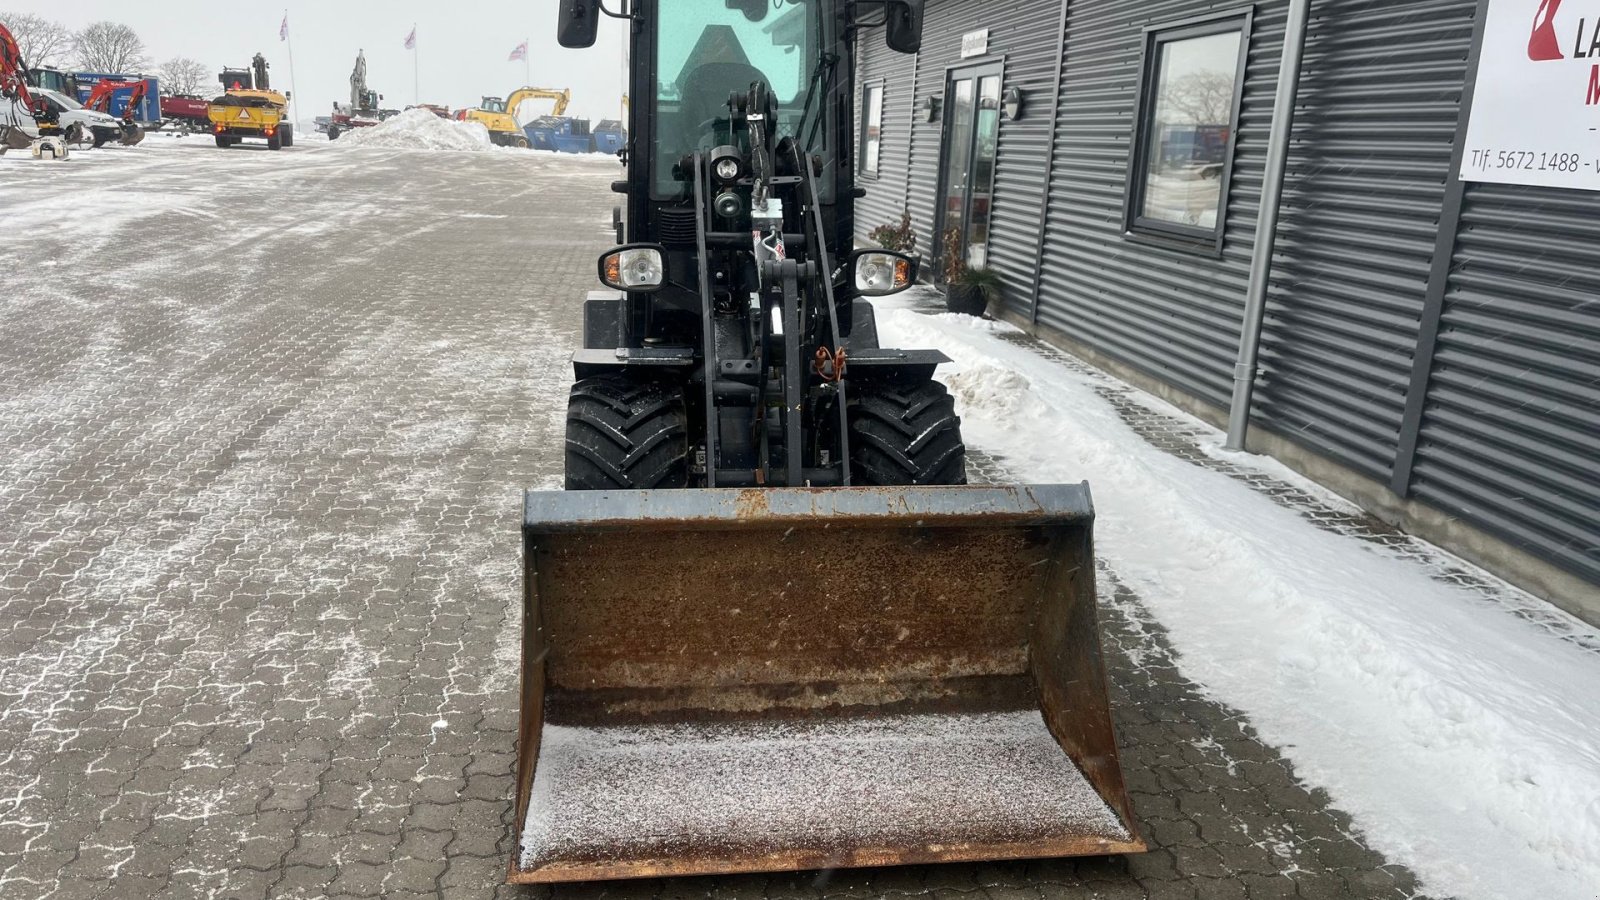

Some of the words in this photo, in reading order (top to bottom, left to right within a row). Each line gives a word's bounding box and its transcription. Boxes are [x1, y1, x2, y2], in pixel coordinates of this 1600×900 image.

[1471, 149, 1491, 172] Tlf.
[1496, 150, 1535, 170] 5672
[1538, 152, 1580, 172] 1488
